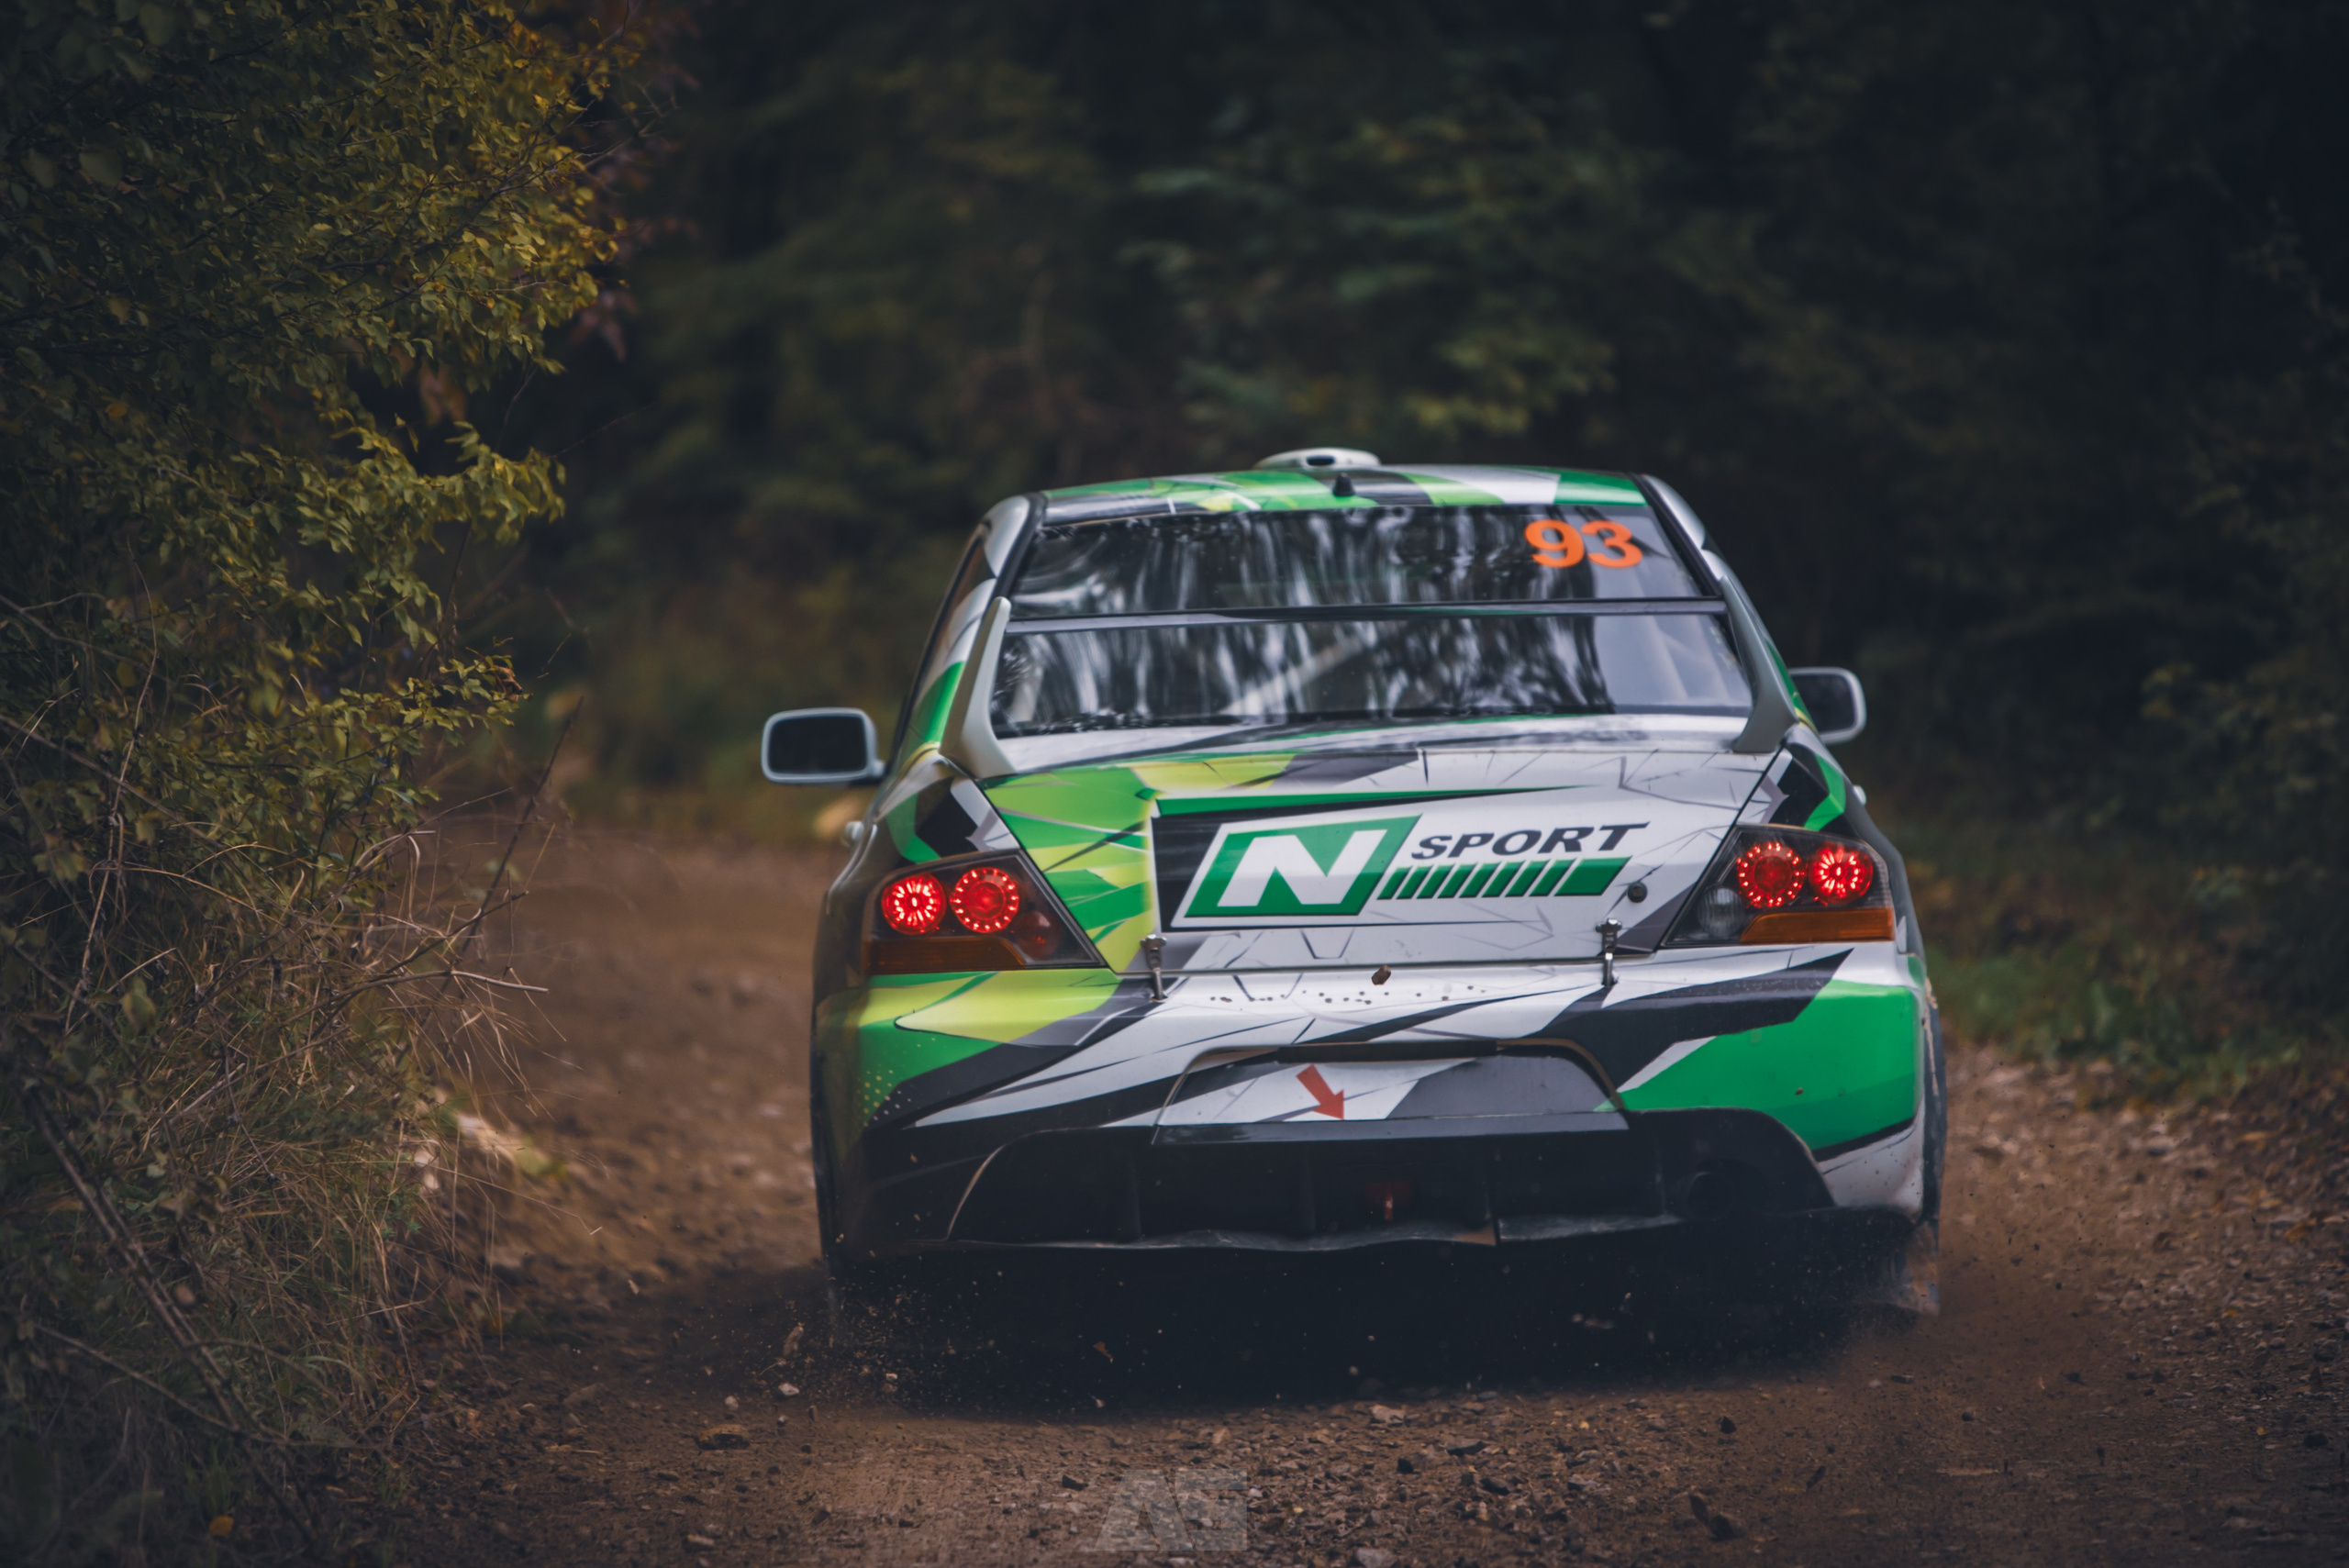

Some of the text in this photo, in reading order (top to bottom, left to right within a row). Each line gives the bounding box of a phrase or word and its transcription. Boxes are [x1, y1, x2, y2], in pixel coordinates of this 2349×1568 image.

[1524, 519, 1642, 568] 93
[1217, 821, 1650, 906] N SPORT
